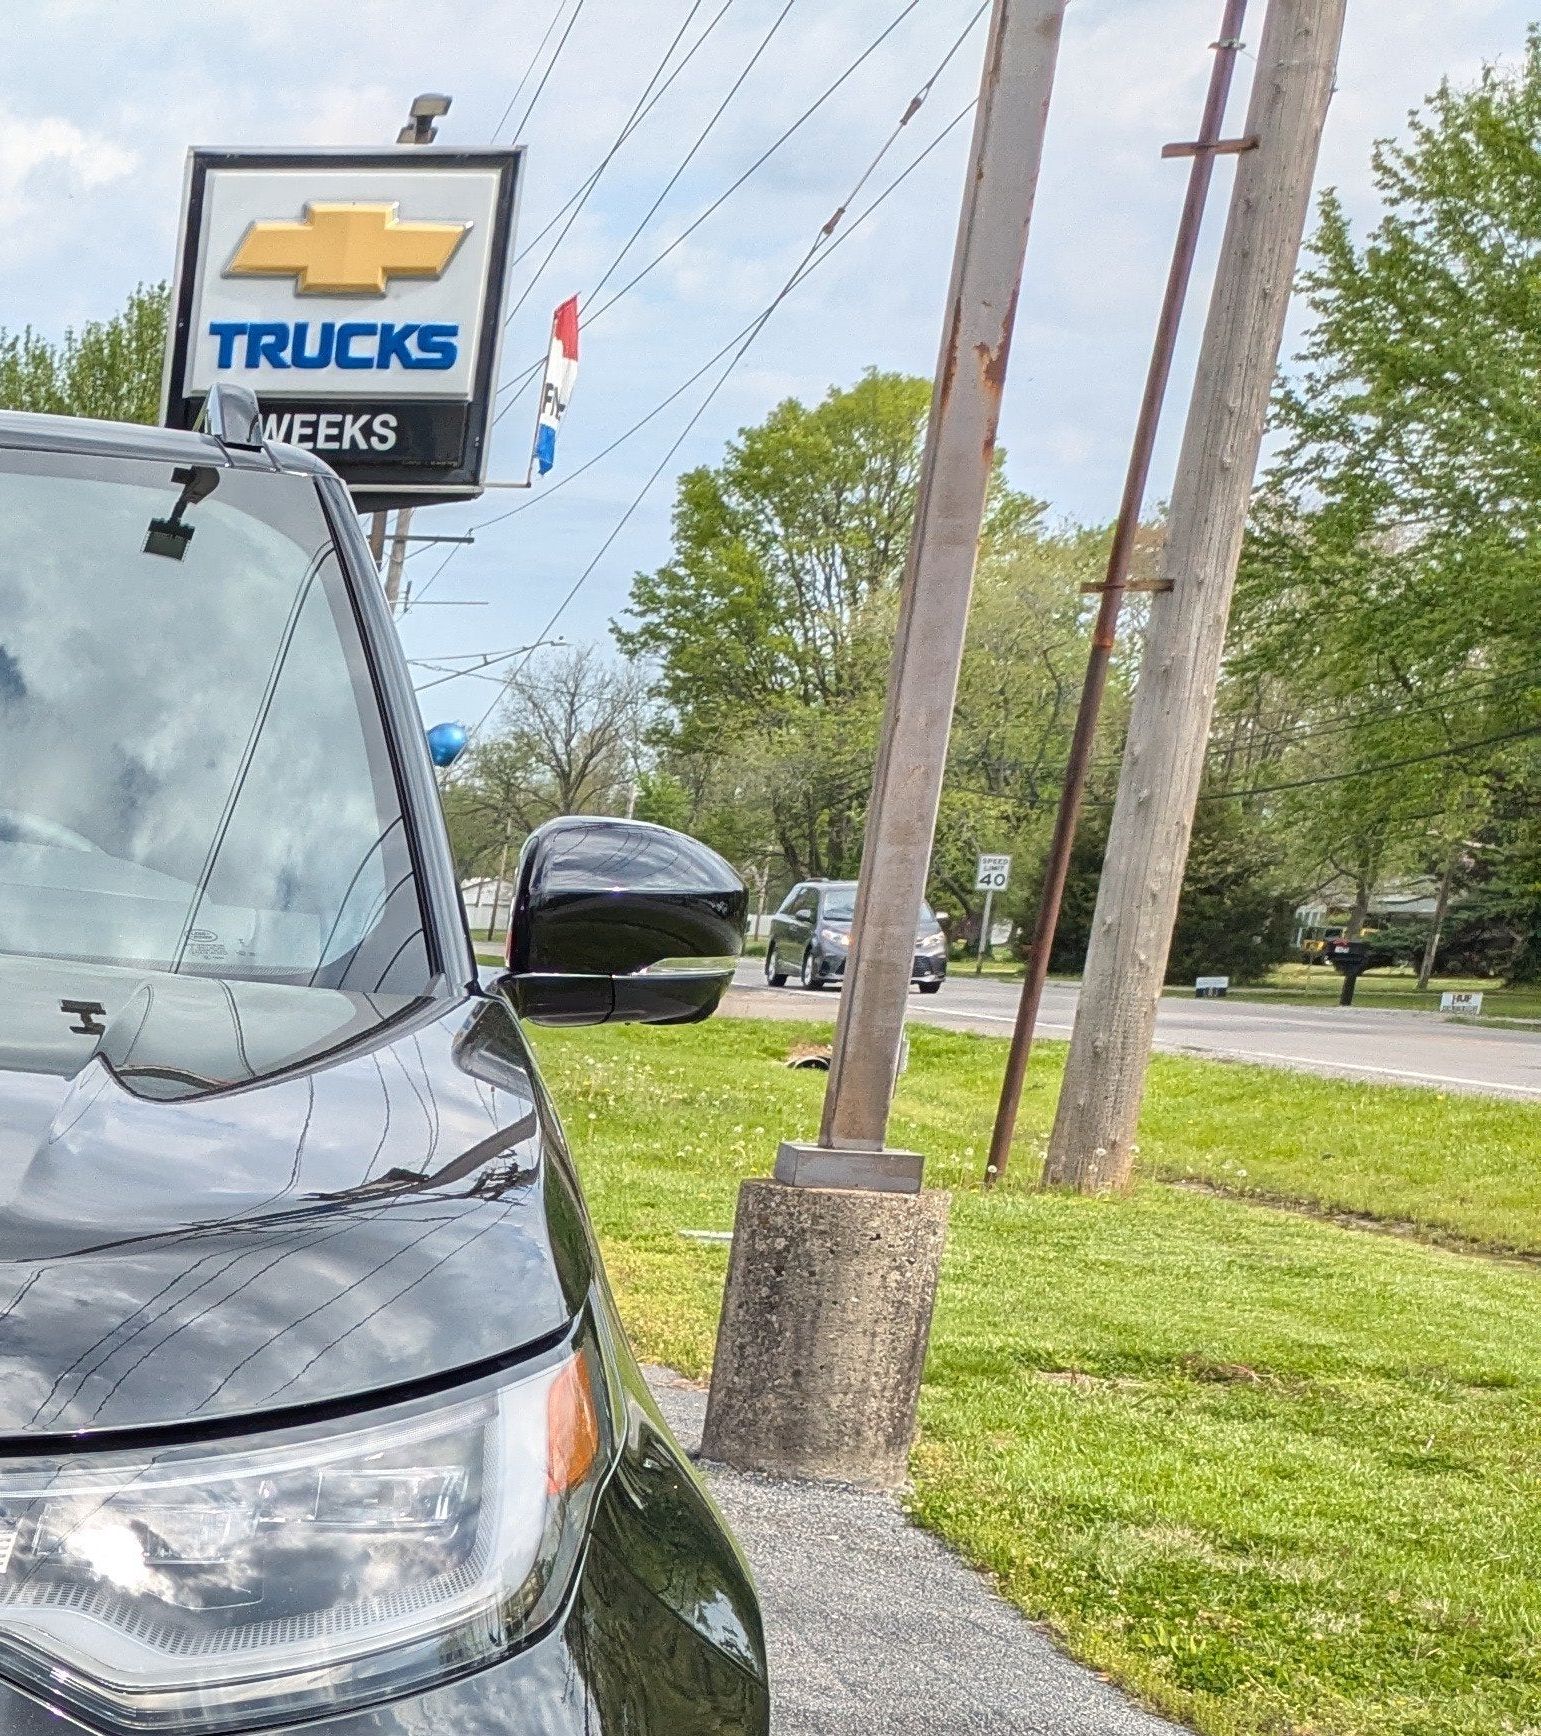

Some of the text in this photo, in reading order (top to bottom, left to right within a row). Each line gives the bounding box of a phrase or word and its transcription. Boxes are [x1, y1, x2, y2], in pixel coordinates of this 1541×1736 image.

[209, 321, 459, 370] TRUCKS
[258, 413, 398, 451] WEEKS
[979, 873, 1006, 887] 40
